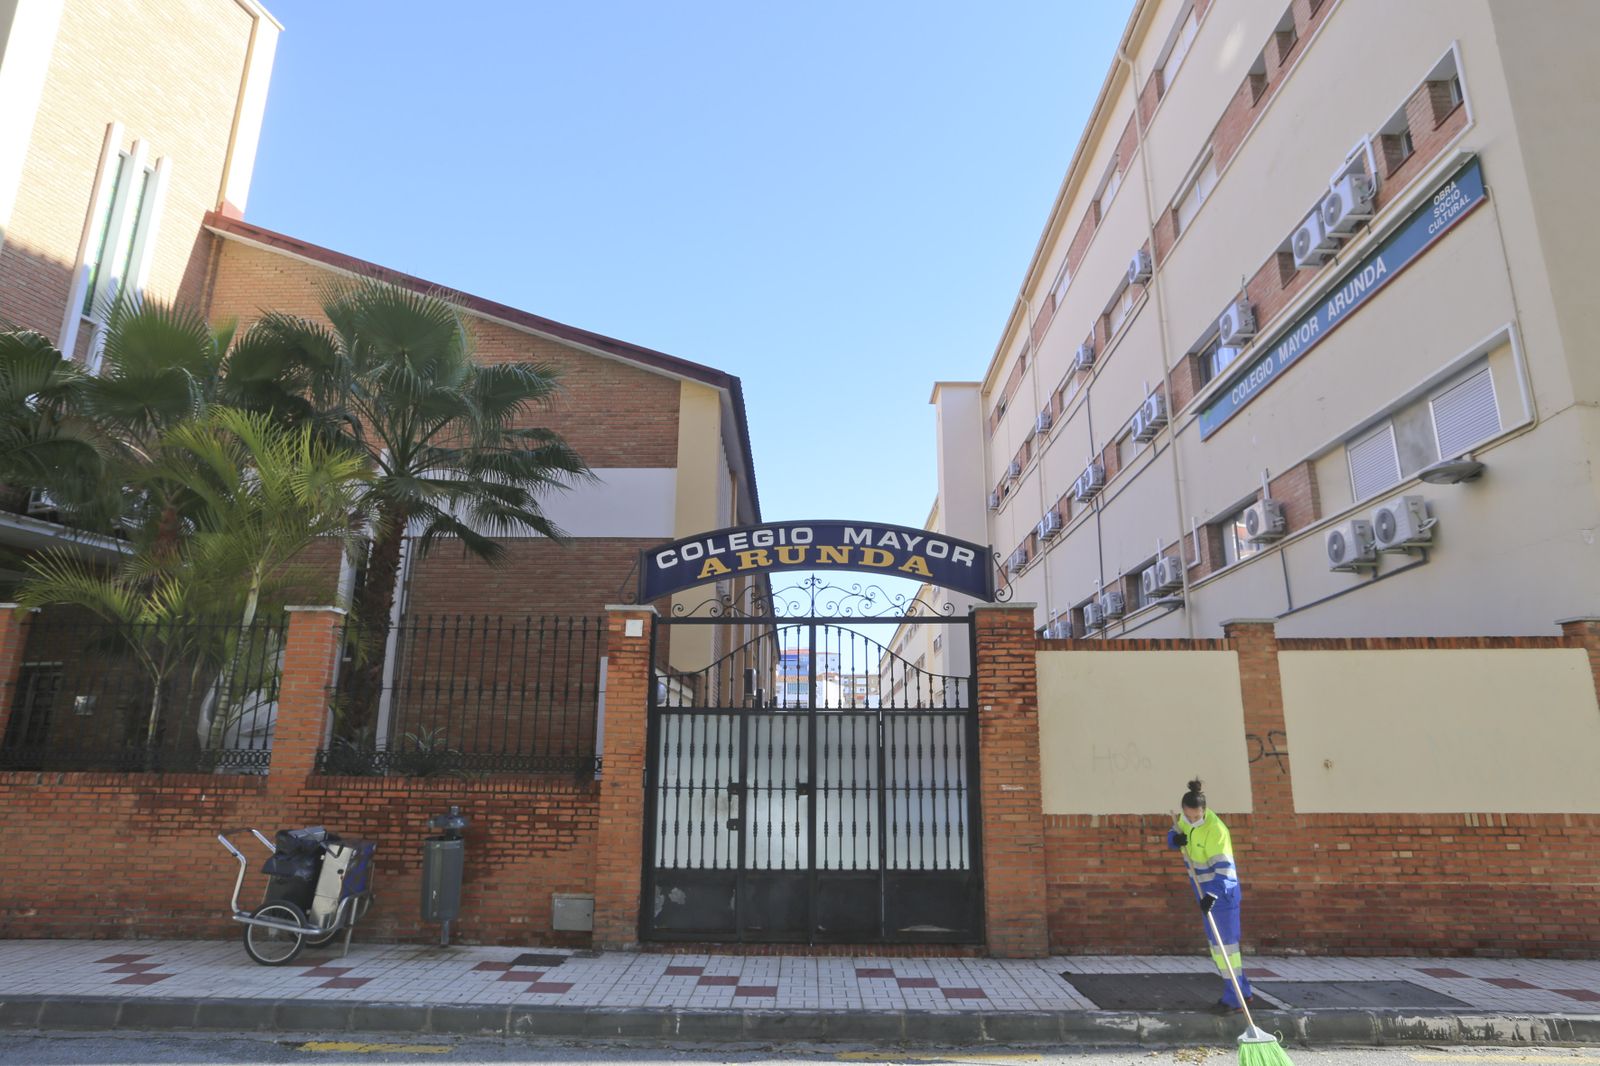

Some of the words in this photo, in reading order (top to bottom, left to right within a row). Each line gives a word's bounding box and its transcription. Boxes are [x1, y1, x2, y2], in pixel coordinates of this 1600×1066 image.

[1433, 181, 1457, 206] OBRA
[1433, 189, 1460, 218] SOCIO
[1428, 194, 1471, 234] CULTURAL
[1231, 358, 1274, 405] COLEGIO
[1278, 315, 1320, 365] MAYOR
[1327, 256, 1387, 322] ARUNDA
[656, 527, 814, 569] COLEGIO
[843, 527, 976, 568] MAYOR
[697, 545, 934, 579] ARUNDA
